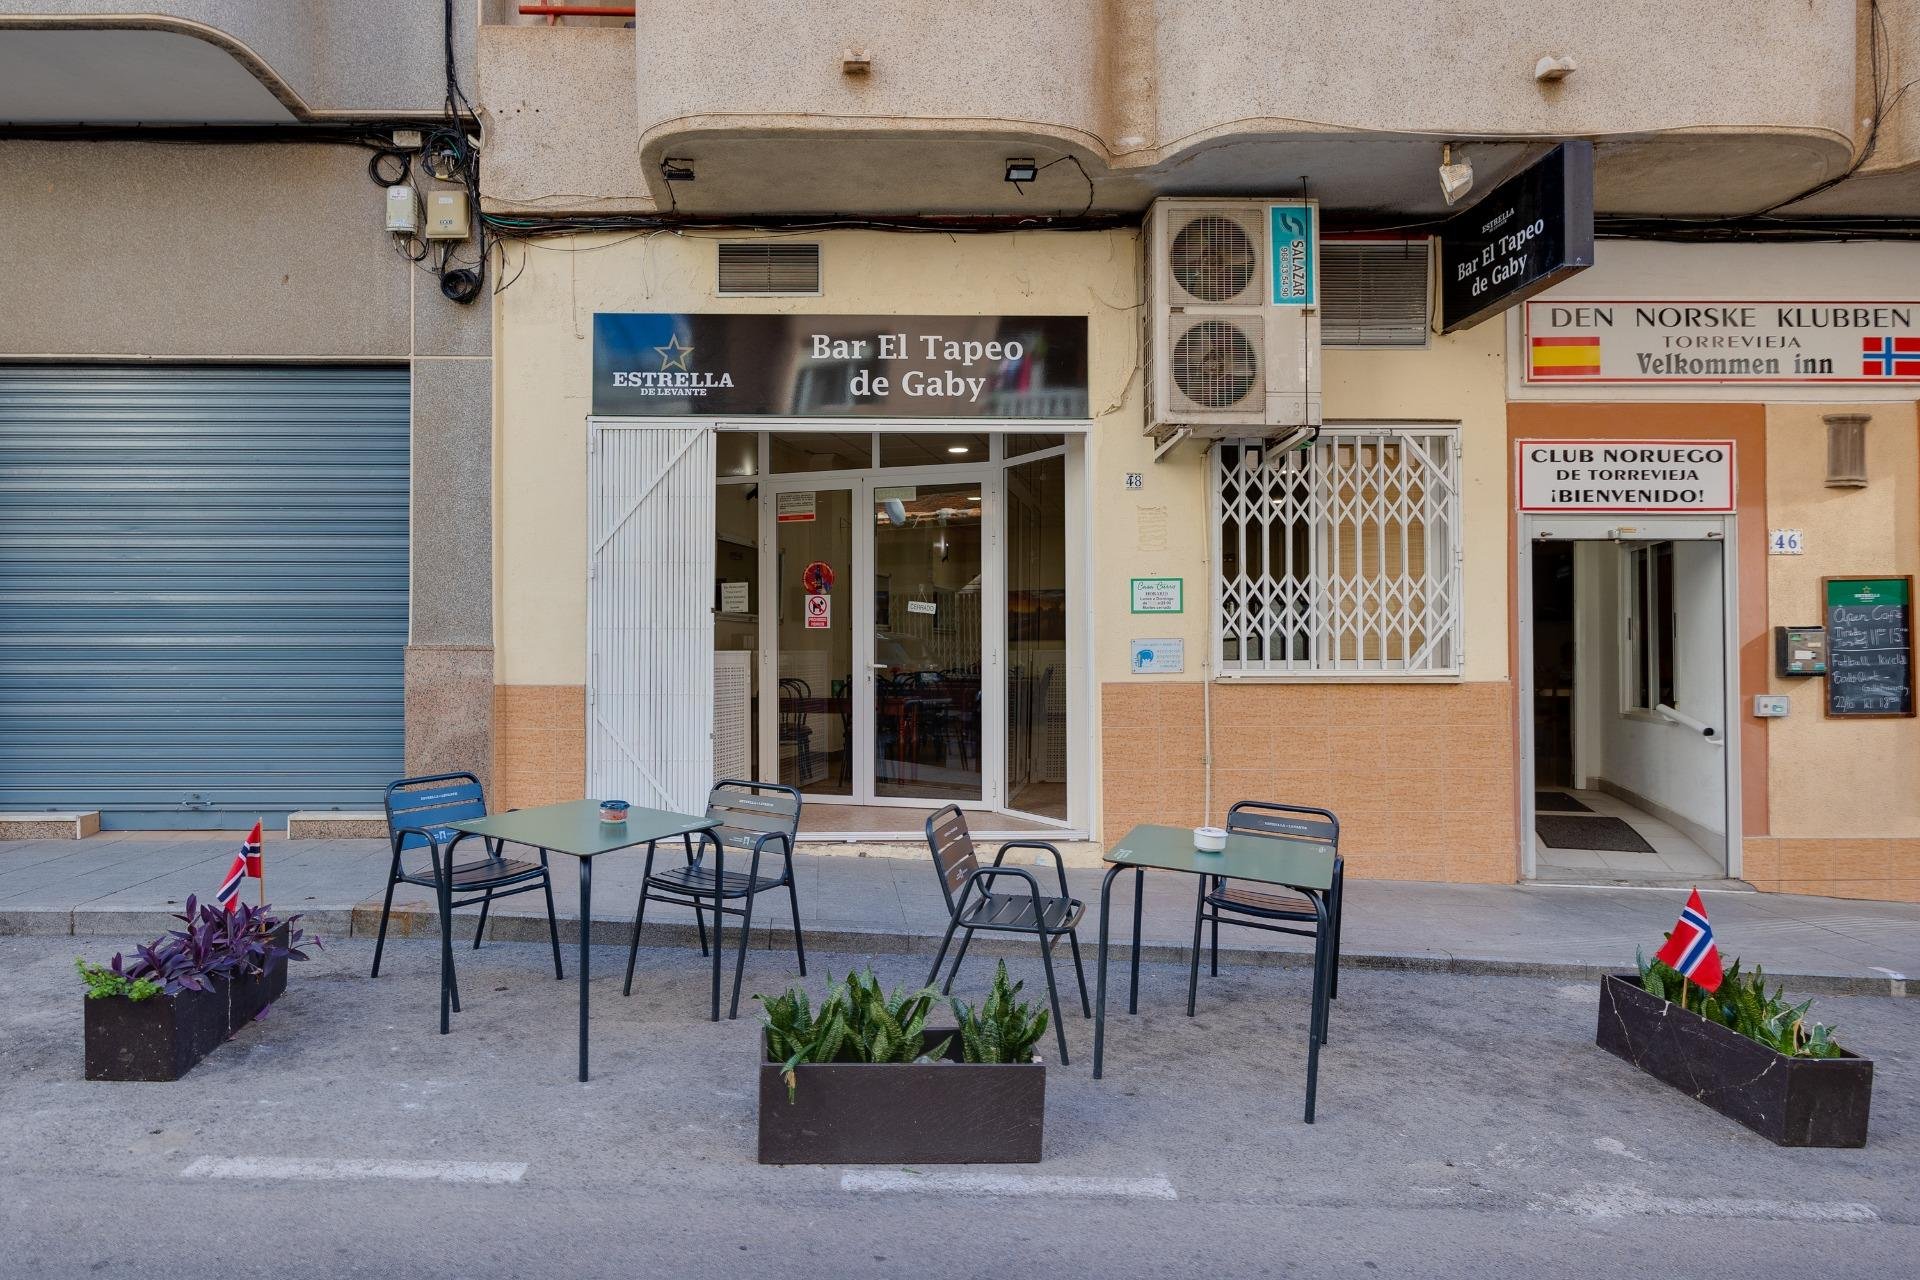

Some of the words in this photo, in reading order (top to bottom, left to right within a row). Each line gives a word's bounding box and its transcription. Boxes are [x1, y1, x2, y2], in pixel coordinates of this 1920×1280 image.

[1481, 207, 1515, 234] ESTRELLA
[1457, 257, 1479, 281] Bar
[1482, 244, 1495, 267] El
[1498, 218, 1544, 256] Tapeo
[1281, 264, 1289, 274] 33
[1291, 240, 1305, 297] SALAZAR
[1472, 276, 1488, 297] de
[1491, 255, 1528, 286] Gaby
[1282, 287, 1289, 297] 90
[1551, 307, 1614, 328] DEN
[1636, 307, 1757, 328] NORSKE
[1778, 307, 1911, 328] KLUBBEN
[1663, 335, 1802, 348] TORREVIEJA
[810, 335, 866, 361] Bar
[878, 334, 909, 361] El
[919, 335, 1024, 366] Tapeo
[1636, 352, 1780, 375] Velkommen
[1793, 353, 1834, 374] inn
[612, 372, 734, 389] ESTRELLA
[849, 369, 889, 396] de
[901, 370, 987, 403] Gaby
[640, 388, 656, 397] DE
[657, 388, 707, 397] LEVANTE
[1531, 449, 1594, 463] CLUB
[1603, 449, 1724, 463] NORUEGO
[1126, 475, 1142, 488] 48
[1556, 469, 1581, 481] DE
[1587, 469, 1699, 481] TORREVIEJA
[1551, 489, 1705, 504] ¡BIENVENIDO!
[1775, 534, 1797, 549] 46
[909, 603, 935, 612] CERRADO
